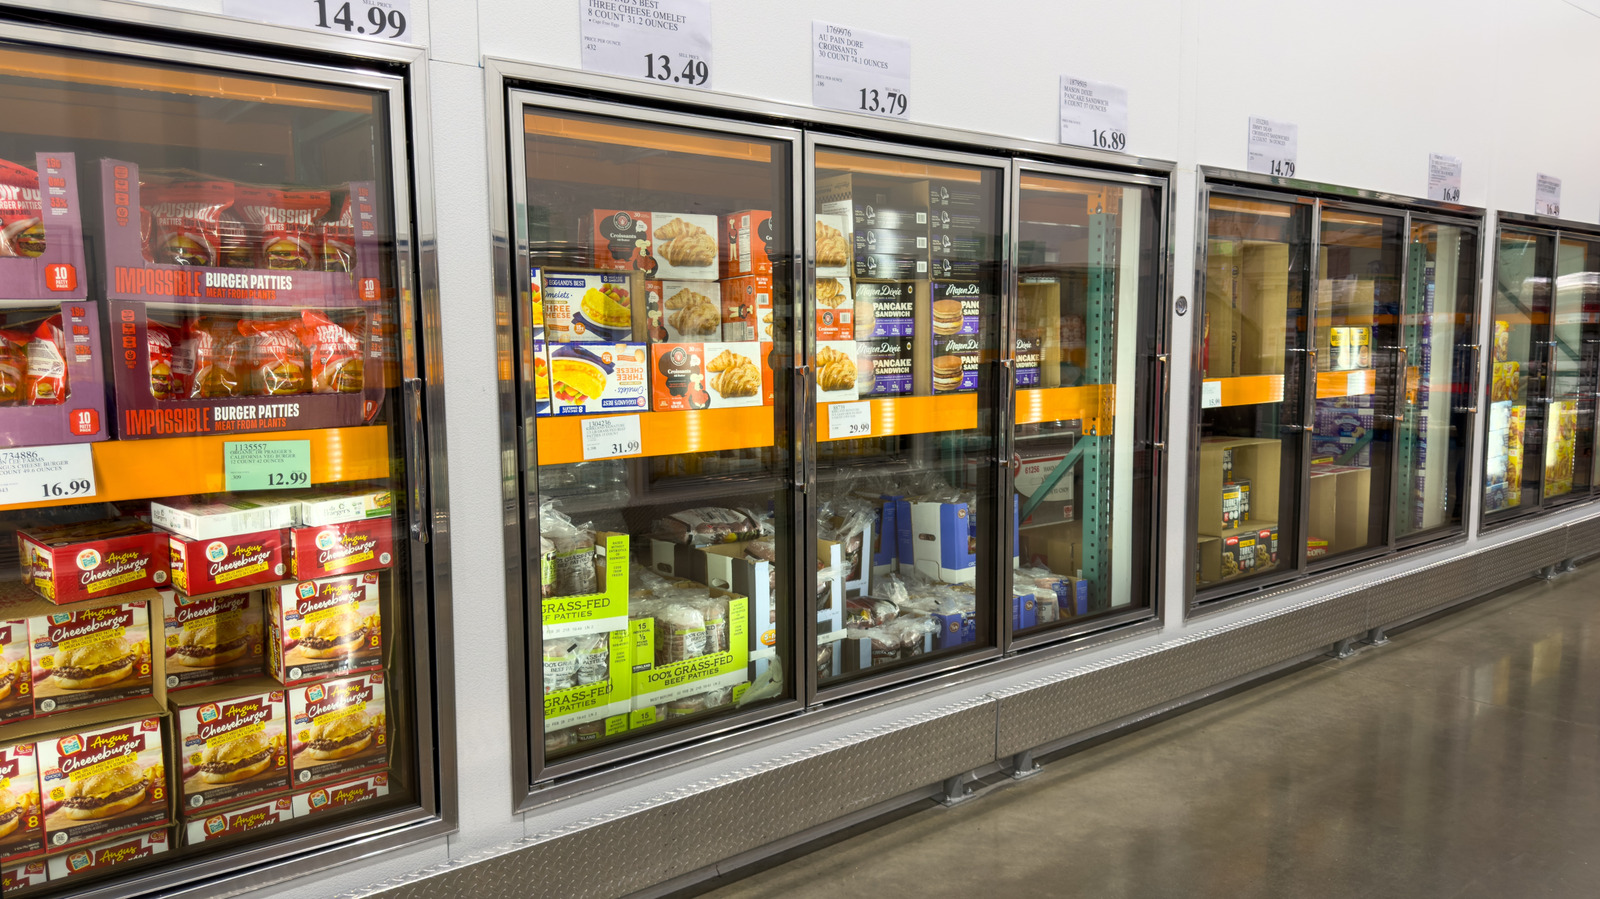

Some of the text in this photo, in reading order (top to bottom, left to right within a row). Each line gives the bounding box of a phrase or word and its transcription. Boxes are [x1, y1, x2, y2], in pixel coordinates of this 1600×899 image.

[639, 0, 660, 9] BEST
[588, 0, 617, 12] THREE
[618, 6, 652, 18] CHEESE
[653, 10, 687, 24] OMELET
[314, 0, 406, 38] 14.99
[588, 8, 679, 31] 8 COUNT 31.2 OUNCES
[826, 25, 852, 37] 1769976
[830, 35, 845, 44] PAIN
[846, 38, 864, 49] DORE
[818, 42, 858, 56] CROISSANTS
[827, 51, 850, 63] COUNT
[863, 58, 888, 69] OUNCES
[644, 53, 709, 86] 13.49
[859, 88, 907, 115] 13.79
[1064, 92, 1085, 101] PANCAKE
[1092, 129, 1126, 150] 16.89
[1270, 159, 1295, 177] 14.79
[1443, 188, 1460, 201] 16.49
[17, 201, 42, 210] PATTIES
[50, 197, 68, 208] 33%
[610, 232, 637, 240] Croissants
[55, 267, 68, 280] 10
[115, 267, 293, 297] IMPOSSIBLE BURGER PATTIES
[364, 280, 374, 291] 10
[206, 288, 276, 300] MEAT FROM PLANTS
[873, 302, 913, 311] PANCAKE
[875, 310, 911, 318] SANDWICH
[75, 345, 91, 355] 33%
[873, 359, 912, 368] PANCAKE
[617, 373, 644, 381] THREE
[875, 367, 910, 375] SANDWICH
[617, 384, 645, 394] Omelets
[602, 399, 614, 407] BEST
[78, 411, 91, 424] 10
[125, 403, 300, 435] IMPOSSIBLE BURGER PATTIES
[215, 417, 287, 431] MEAT FROM PLANTS
[234, 443, 267, 452] 1135557
[612, 441, 639, 454] 31.99
[268, 472, 307, 486] 12.99
[42, 479, 91, 497] 16.99
[340, 535, 368, 546] Angus
[232, 545, 262, 557] Angus
[319, 540, 376, 563] Cheeseburger
[105, 552, 139, 564] Angus
[210, 550, 271, 575] Cheeseburger
[81, 557, 149, 584] Cheeseburger
[322, 583, 353, 596] Angus
[299, 589, 362, 615] Cheeseburger
[541, 597, 611, 614] GRASS-FED
[80, 607, 118, 621] Angus
[178, 597, 245, 623] Cheeseburger
[554, 610, 593, 621] PATTIES
[52, 614, 129, 642] Cheeseburger
[638, 622, 647, 630] 15
[371, 635, 379, 646] 8
[254, 643, 262, 654] 8
[140, 663, 150, 674] 8
[648, 655, 734, 683] 100% GRASS-FED
[664, 668, 719, 686] BEEF PATTIES
[19, 682, 29, 695] 8
[330, 684, 360, 698] Angus
[544, 677, 613, 708] GRASS-FED
[225, 704, 259, 717] Angus
[308, 690, 369, 718] Cheeseburger
[559, 698, 596, 713] PATTIES
[201, 709, 269, 740] Cheeseburger
[90, 733, 129, 749] Angus
[378, 734, 385, 745] 8
[62, 739, 141, 773] Cheeseburger
[278, 755, 286, 766] 8
[154, 787, 163, 799] 8
[334, 786, 365, 802] Angus
[28, 815, 38, 828] 8
[232, 811, 266, 828] Angus
[99, 846, 137, 863] Angus
